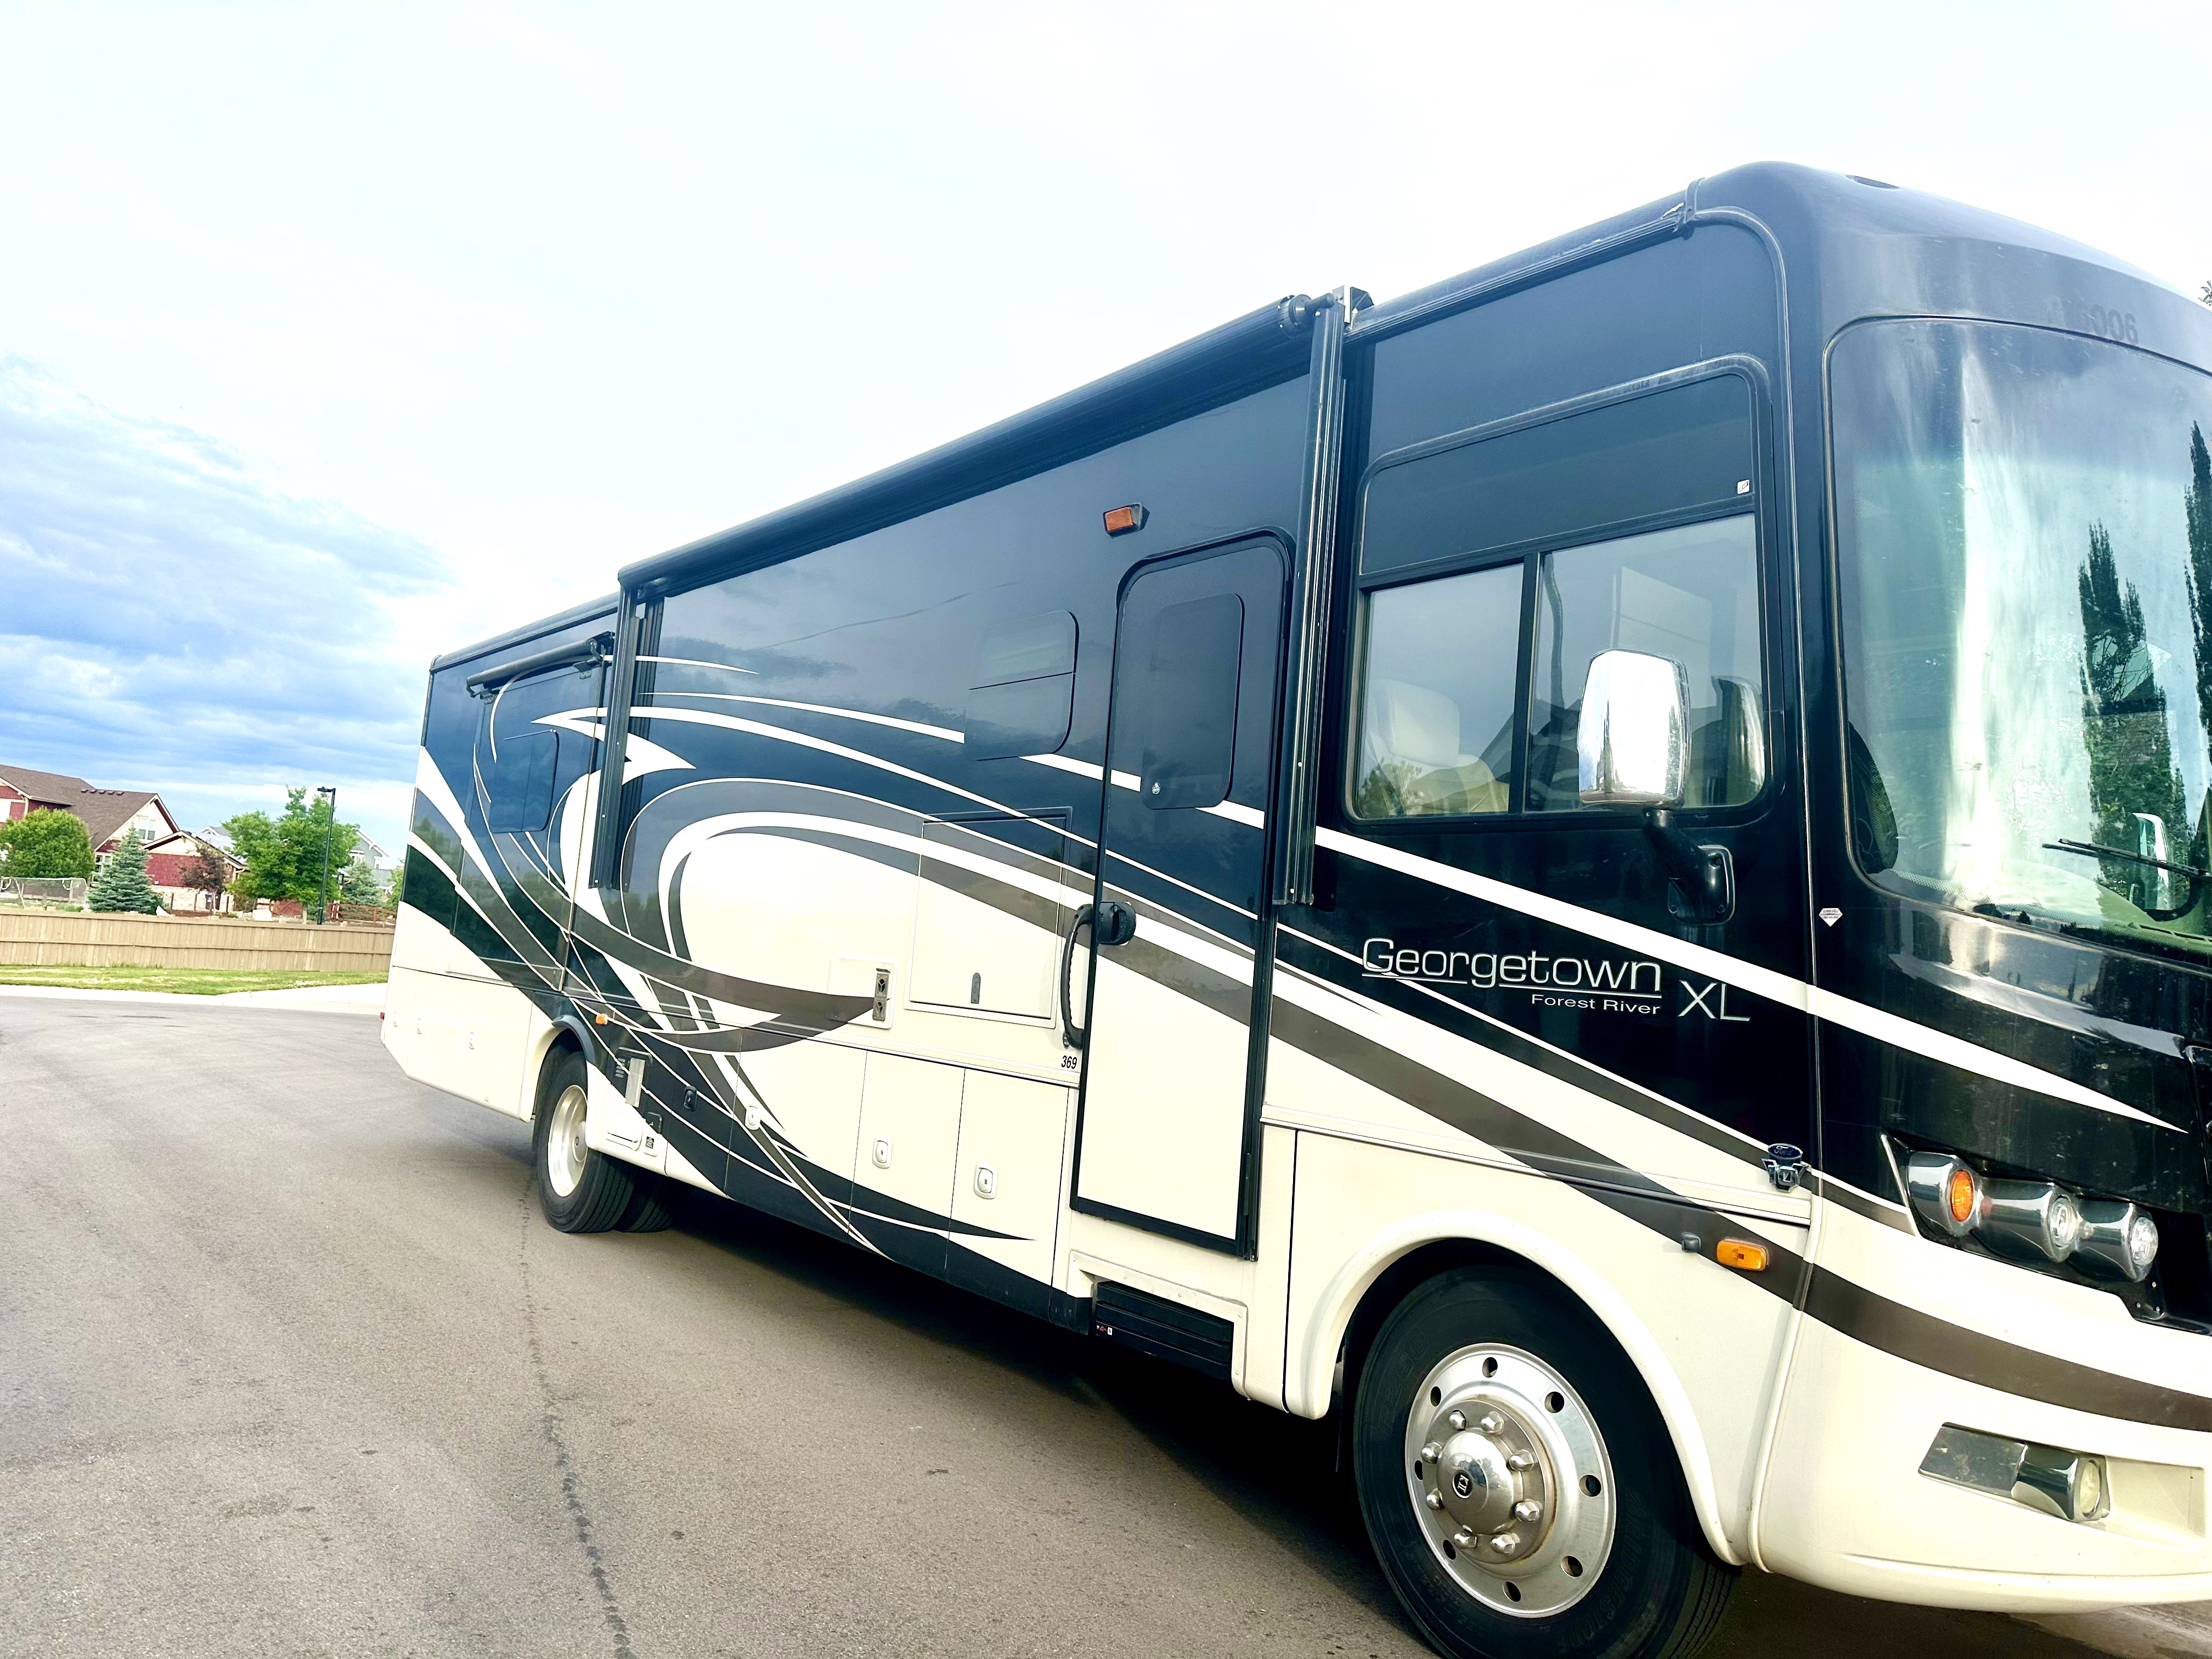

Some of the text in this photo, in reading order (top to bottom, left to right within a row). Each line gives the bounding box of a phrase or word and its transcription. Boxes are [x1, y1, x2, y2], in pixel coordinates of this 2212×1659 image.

[1363, 938, 1751, 1022] Georgetown XL
[1532, 994, 1661, 1015] Forest River
[1061, 1055, 1077, 1069] 369
[1774, 1145, 1794, 1156] Ford
